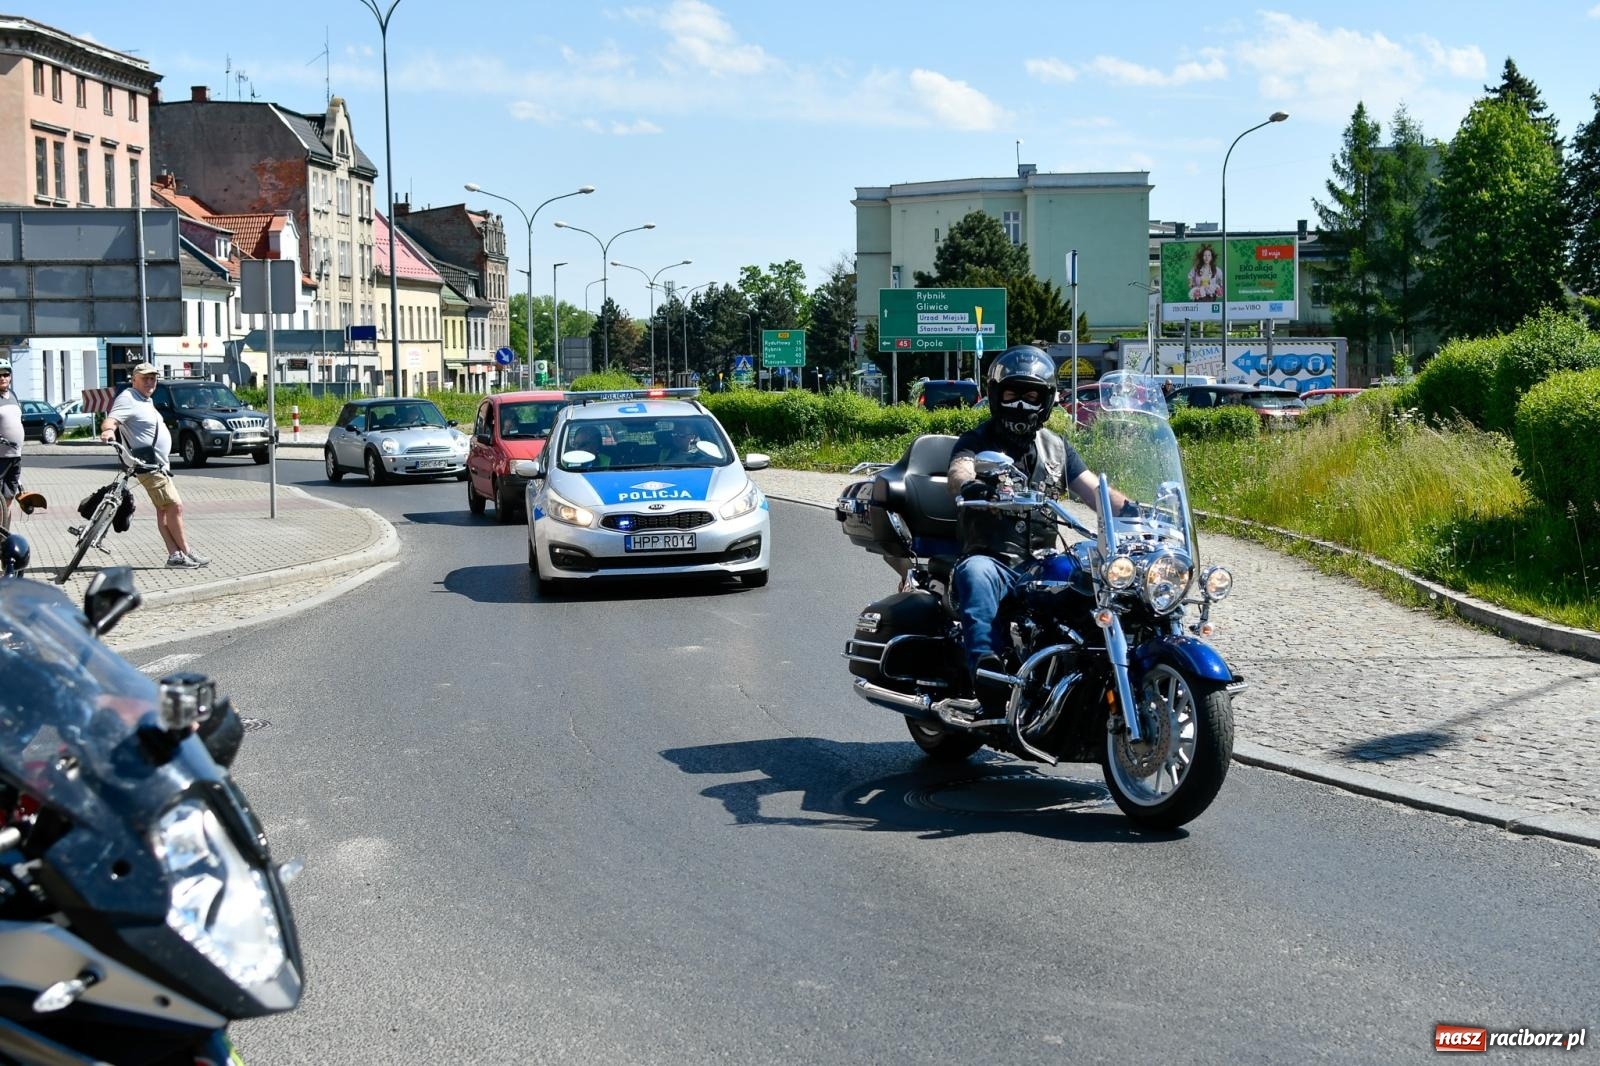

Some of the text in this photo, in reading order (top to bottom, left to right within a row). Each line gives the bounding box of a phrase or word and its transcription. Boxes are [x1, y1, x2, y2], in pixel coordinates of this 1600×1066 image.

[1240, 263, 1273, 273] EKO akcja
[1235, 272, 1277, 281] reaktywacja
[917, 292, 946, 301] Rybnik
[916, 303, 949, 311] Gliwice
[899, 340, 908, 348] 45
[916, 340, 944, 348] Opole
[1238, 358, 1245, 366] 50
[618, 489, 692, 502] POLICJA
[632, 535, 695, 549] HPP R014
